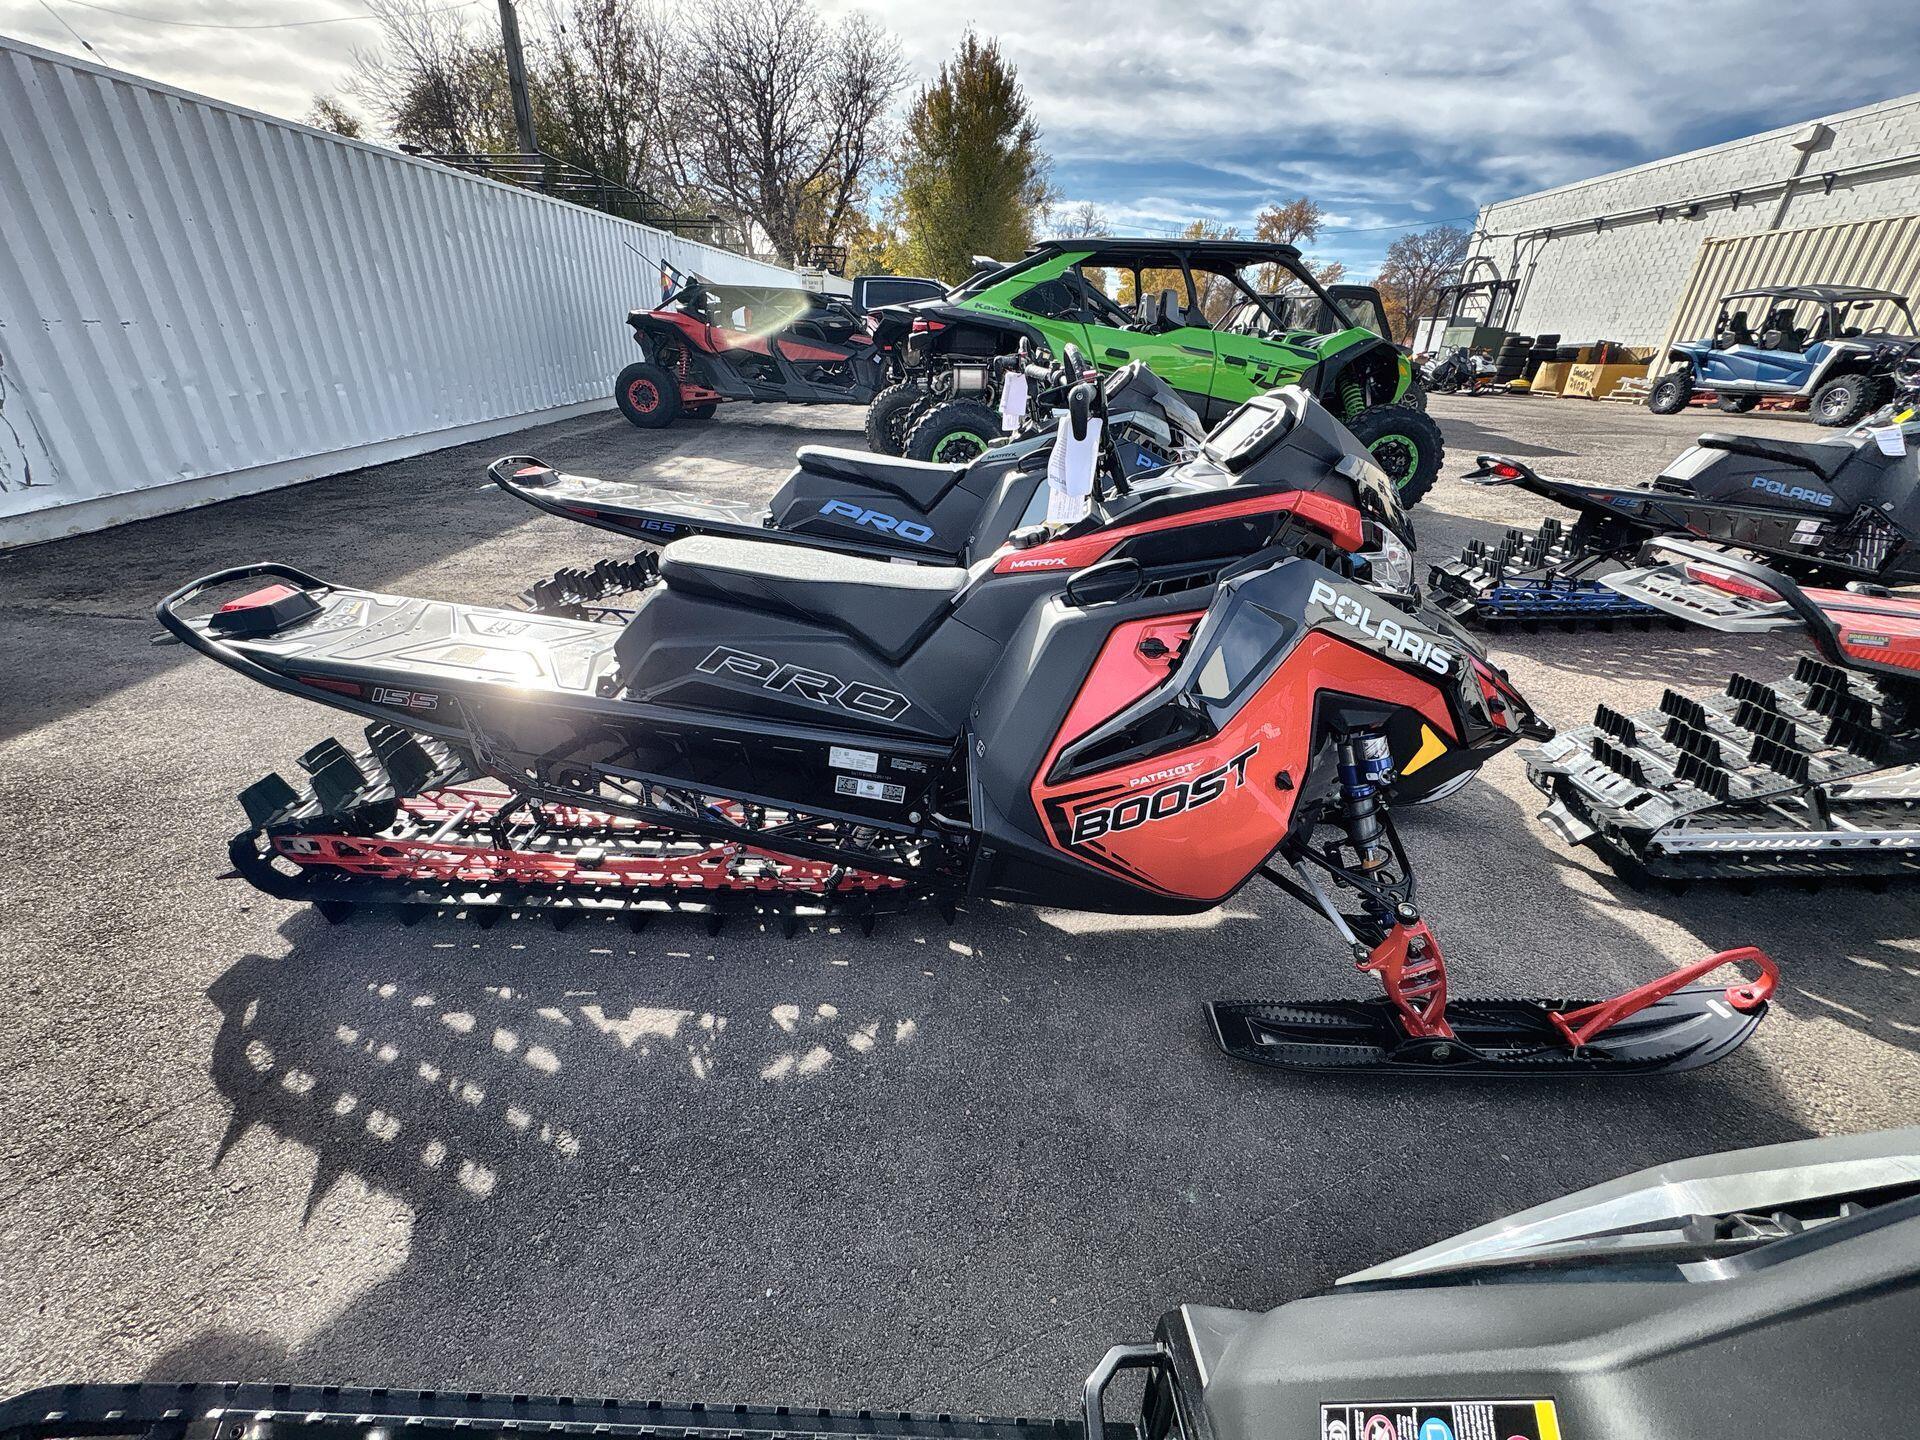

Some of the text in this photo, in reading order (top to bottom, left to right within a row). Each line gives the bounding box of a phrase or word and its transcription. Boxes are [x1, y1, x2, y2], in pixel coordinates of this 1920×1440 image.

[974, 303, 1033, 320] Kawasaki
[987, 452, 1017, 460] MATRYX
[1752, 477, 1834, 507] POLARIS
[640, 520, 676, 533] 165
[818, 499, 935, 543] PRO
[1010, 557, 1068, 569] MATRYX
[1308, 580, 1451, 675] POLARIS
[695, 645, 911, 721] PRO
[371, 687, 439, 710] 155
[1129, 761, 1199, 788] PATRIOT
[1071, 742, 1260, 845] BOOST
